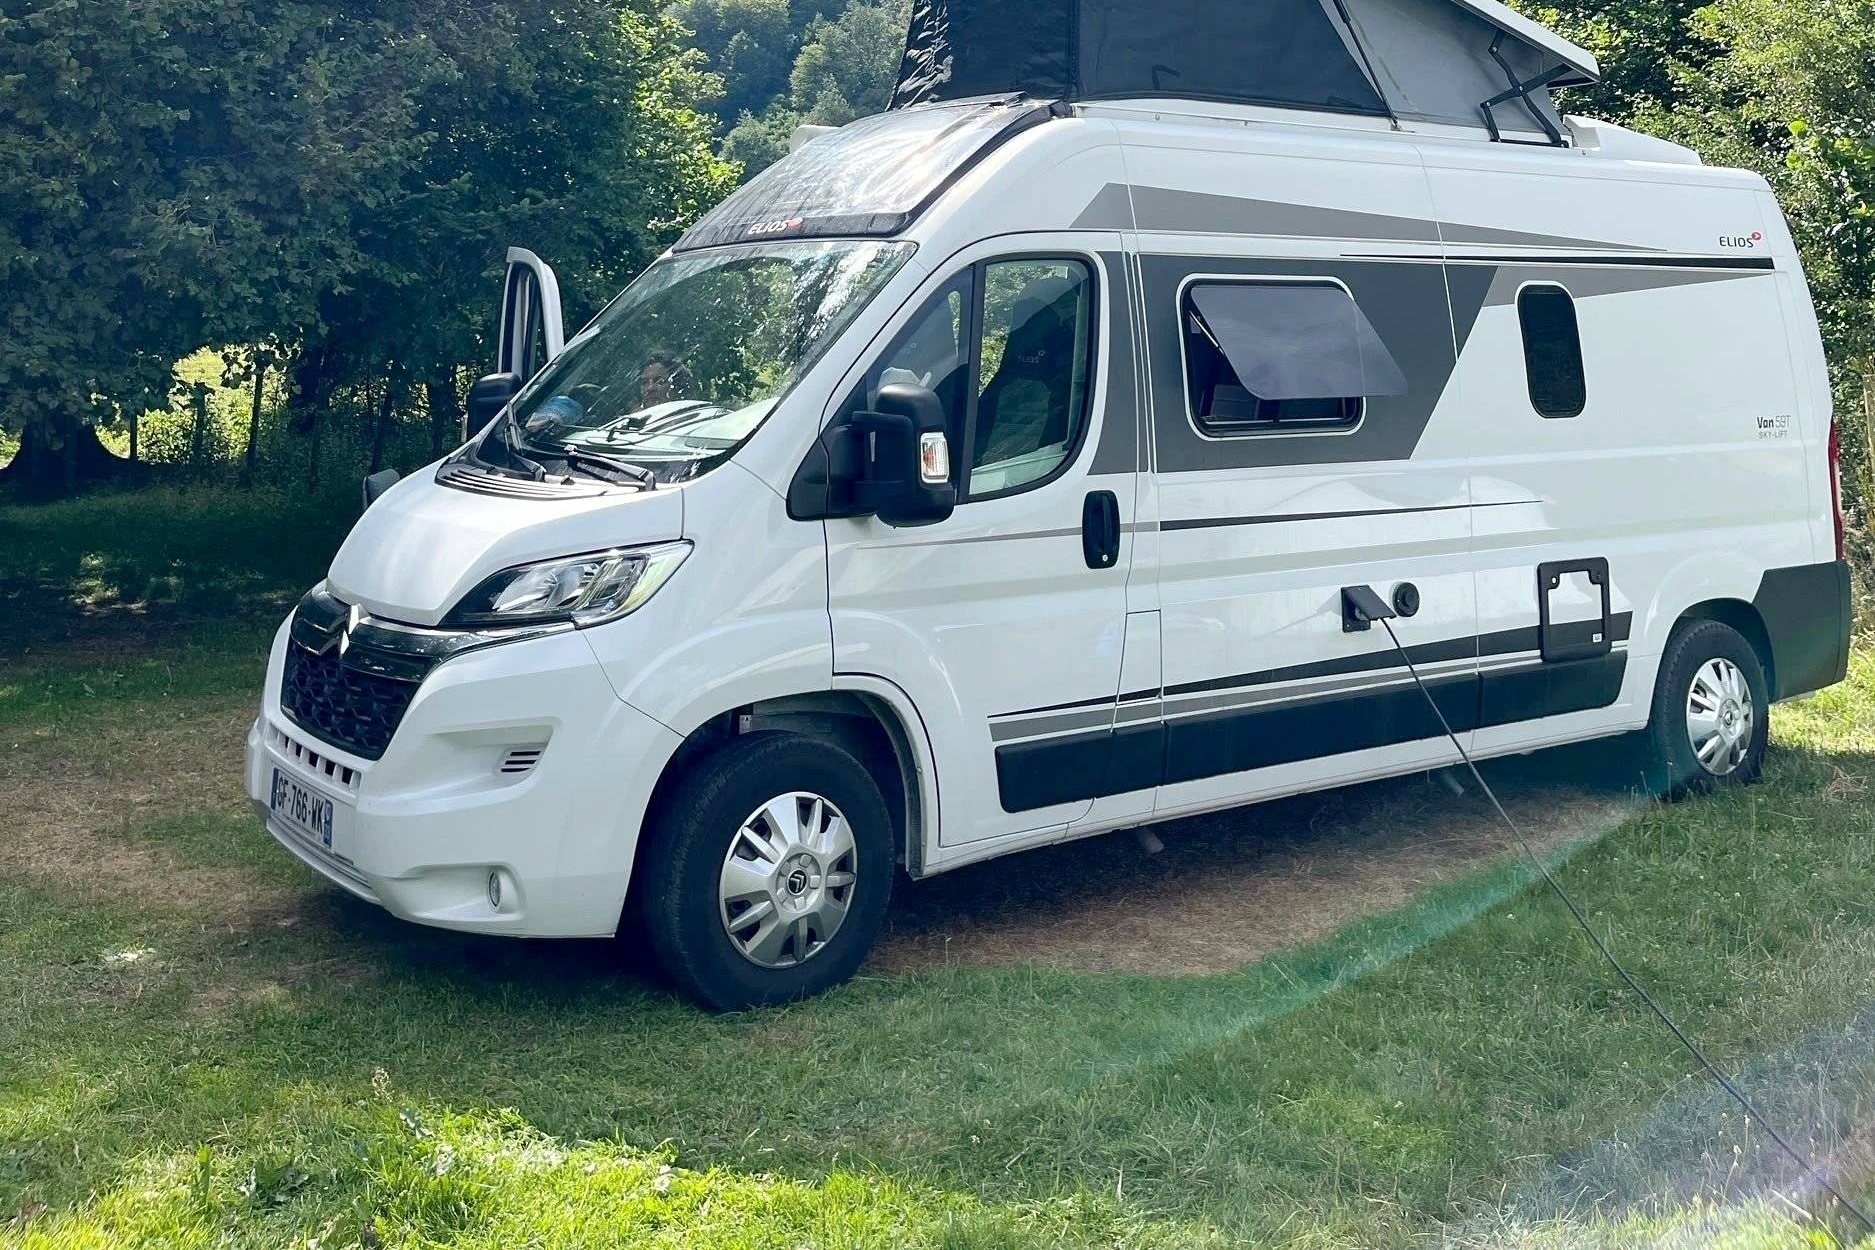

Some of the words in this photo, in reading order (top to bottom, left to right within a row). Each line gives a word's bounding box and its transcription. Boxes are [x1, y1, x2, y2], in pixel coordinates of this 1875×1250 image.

[747, 220, 788, 234] ELIOS
[1719, 236, 1754, 248] ELIOS
[1757, 416, 1774, 429] Van
[1758, 430, 1788, 439] SKY-LIFT
